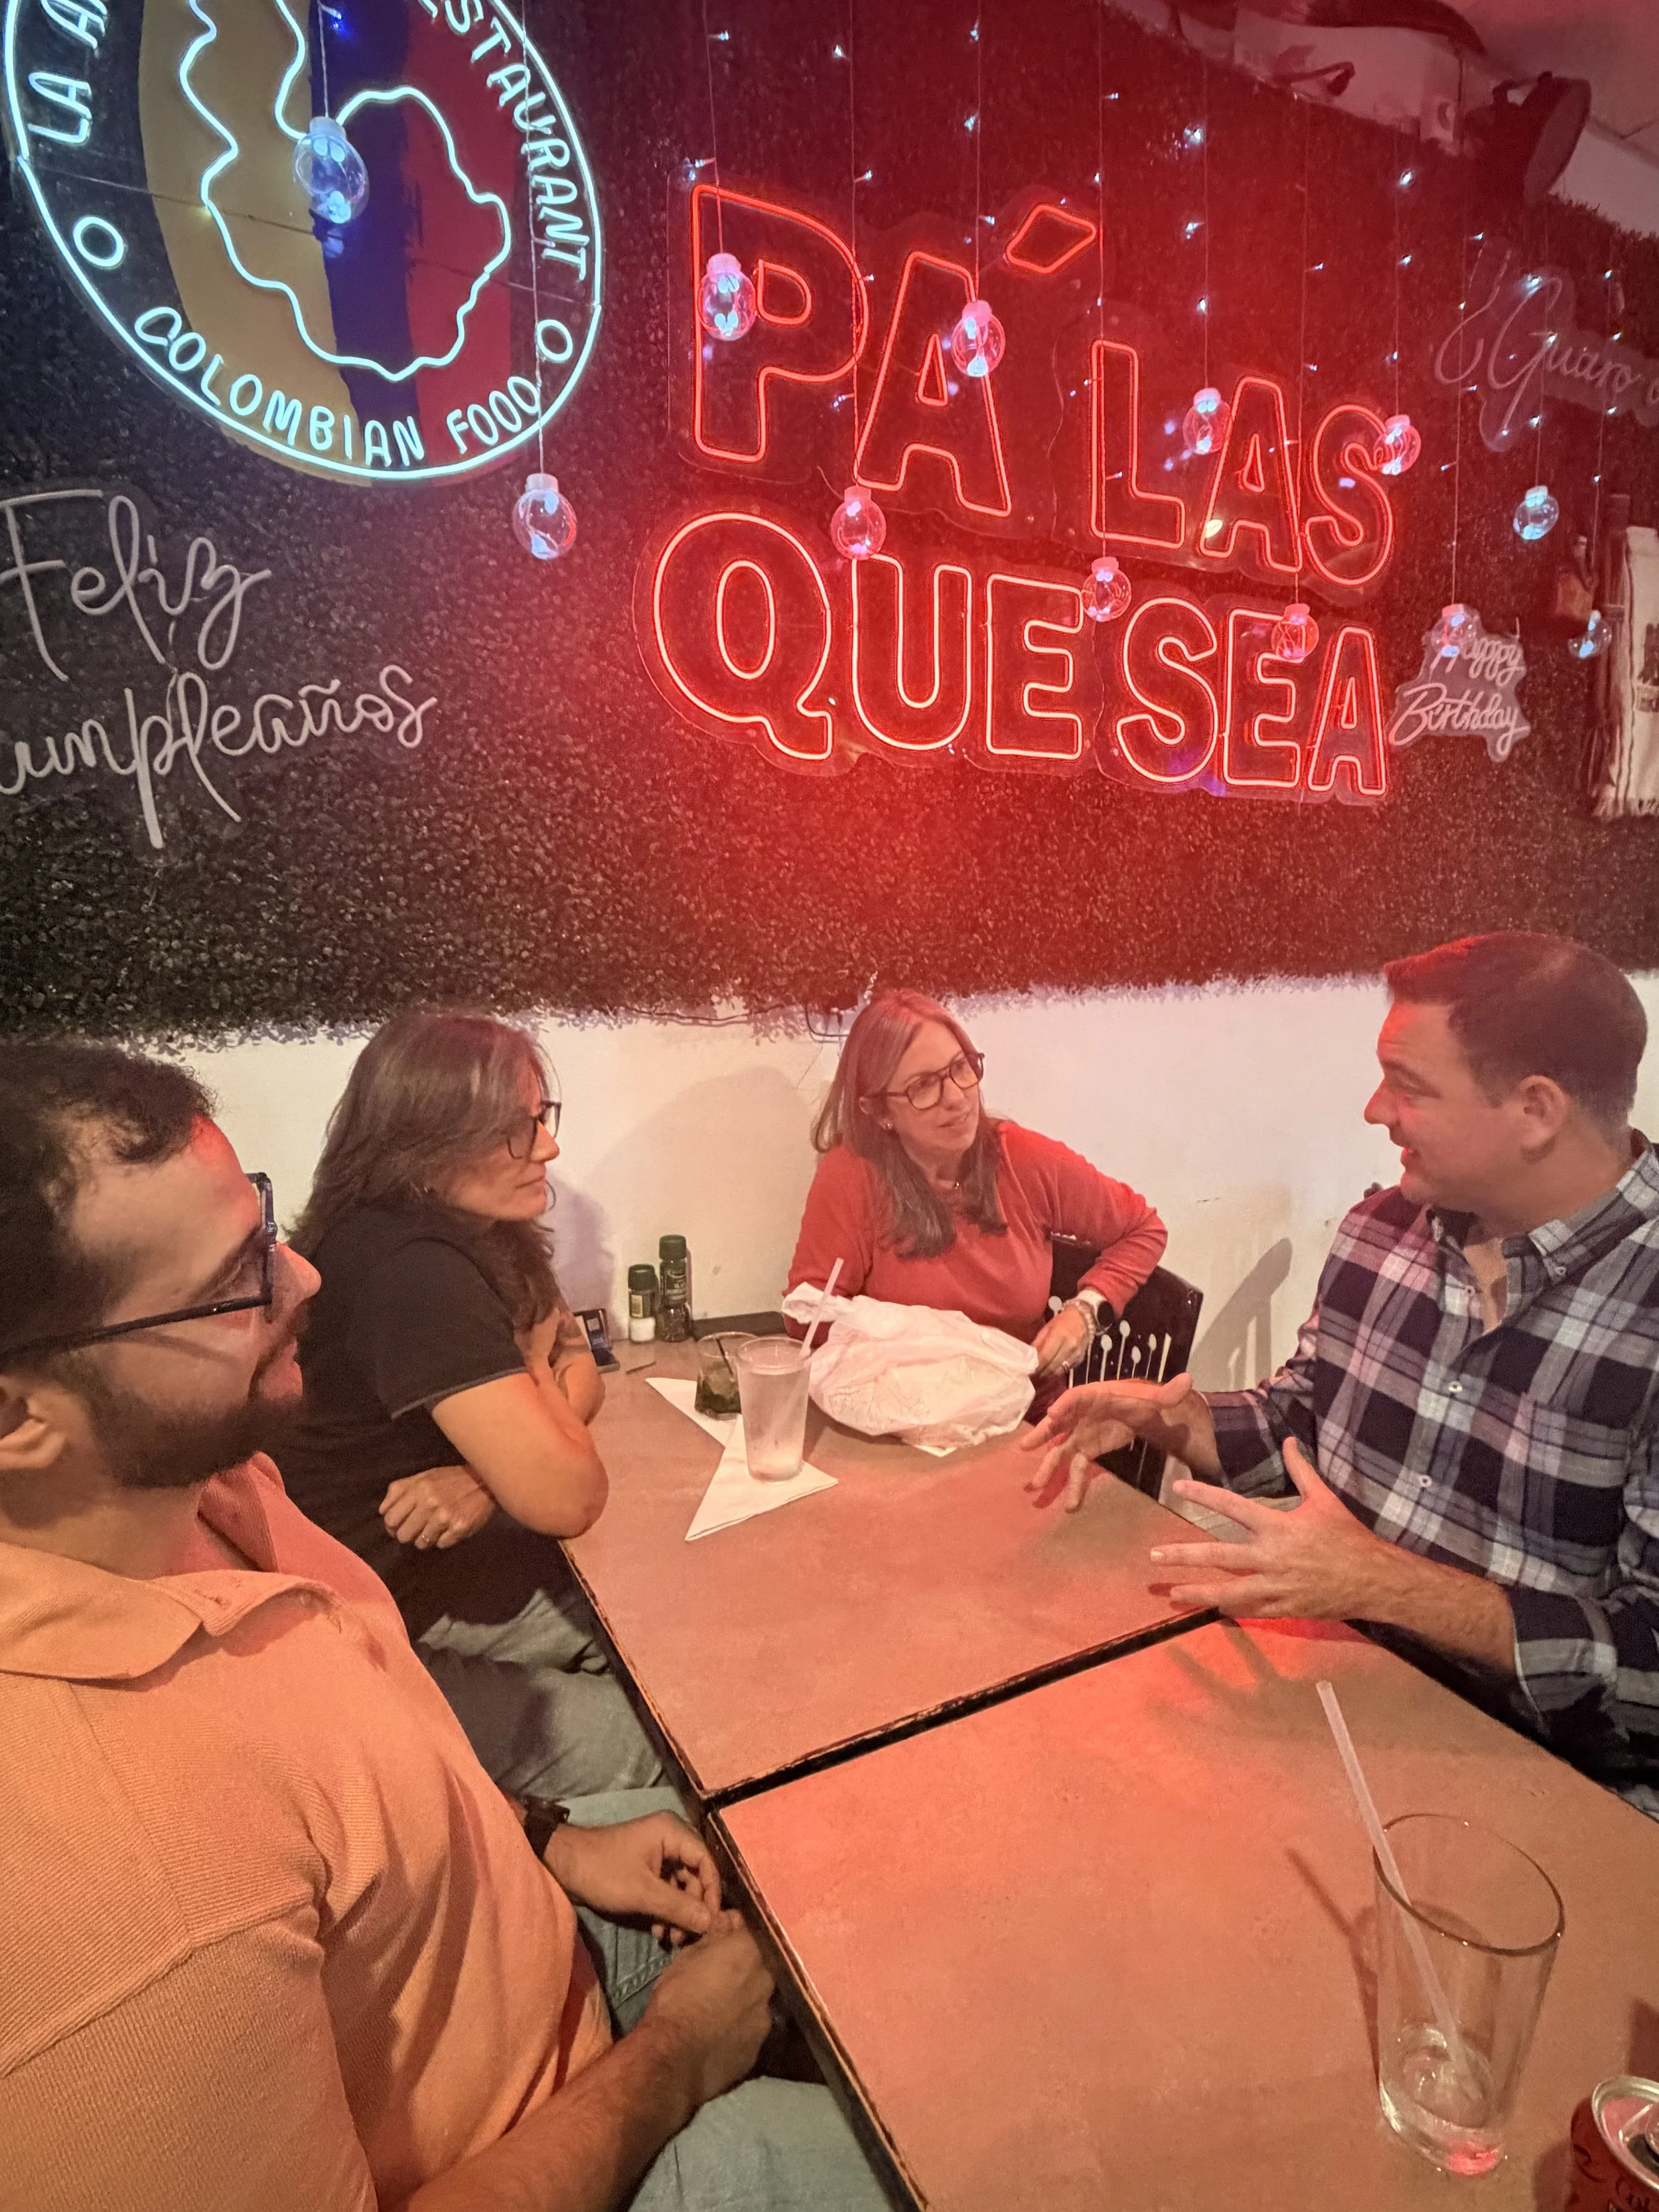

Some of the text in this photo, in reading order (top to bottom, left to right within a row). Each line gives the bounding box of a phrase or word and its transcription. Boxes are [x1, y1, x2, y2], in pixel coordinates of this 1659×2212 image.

[28, 72, 92, 143] LA
[134, 306, 542, 468] COLOMBIAN FOOD
[1090, 338, 1395, 587] LAS
[0, 489, 271, 682] Feliz
[653, 512, 1388, 797] QUE SEA
[0, 664, 438, 849] umpleaños
[1388, 682, 1531, 755] Birthday
